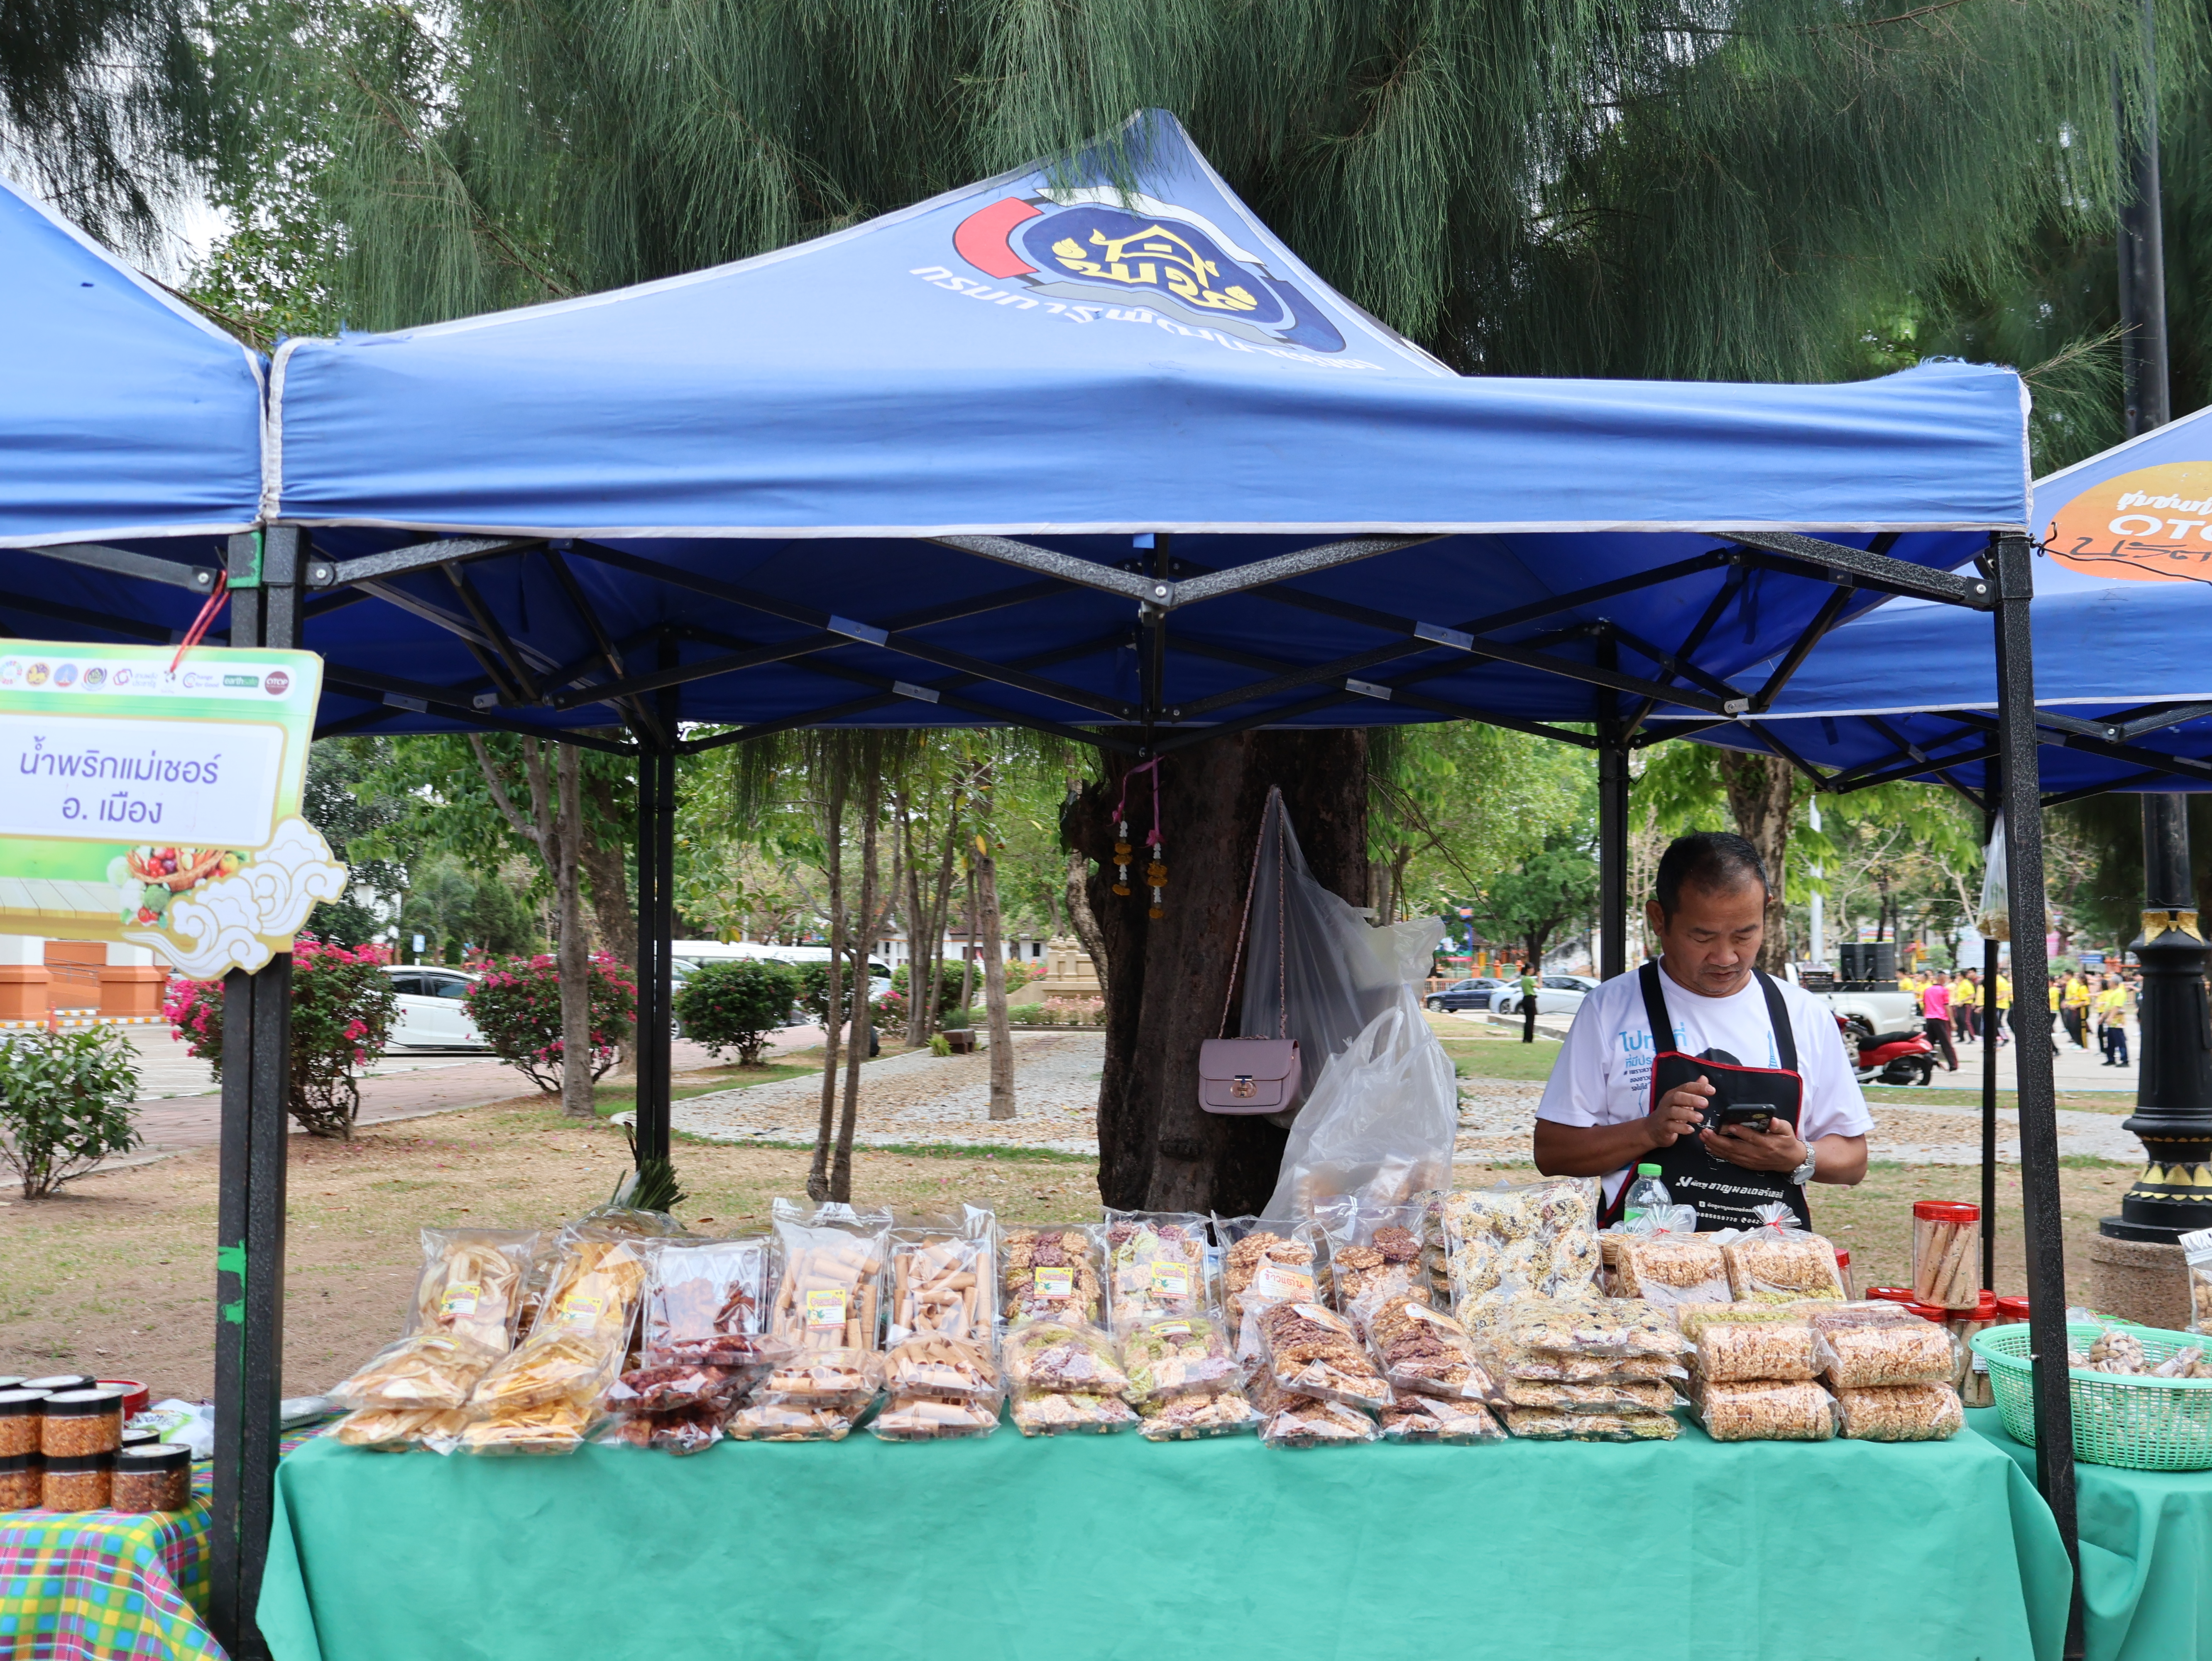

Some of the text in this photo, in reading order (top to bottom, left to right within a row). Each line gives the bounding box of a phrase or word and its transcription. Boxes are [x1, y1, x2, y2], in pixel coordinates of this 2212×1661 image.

[2108, 514, 2212, 542] OT
[20, 735, 222, 784] น้ำพริกแม่เชอร์
[100, 791, 162, 824] เมือง
